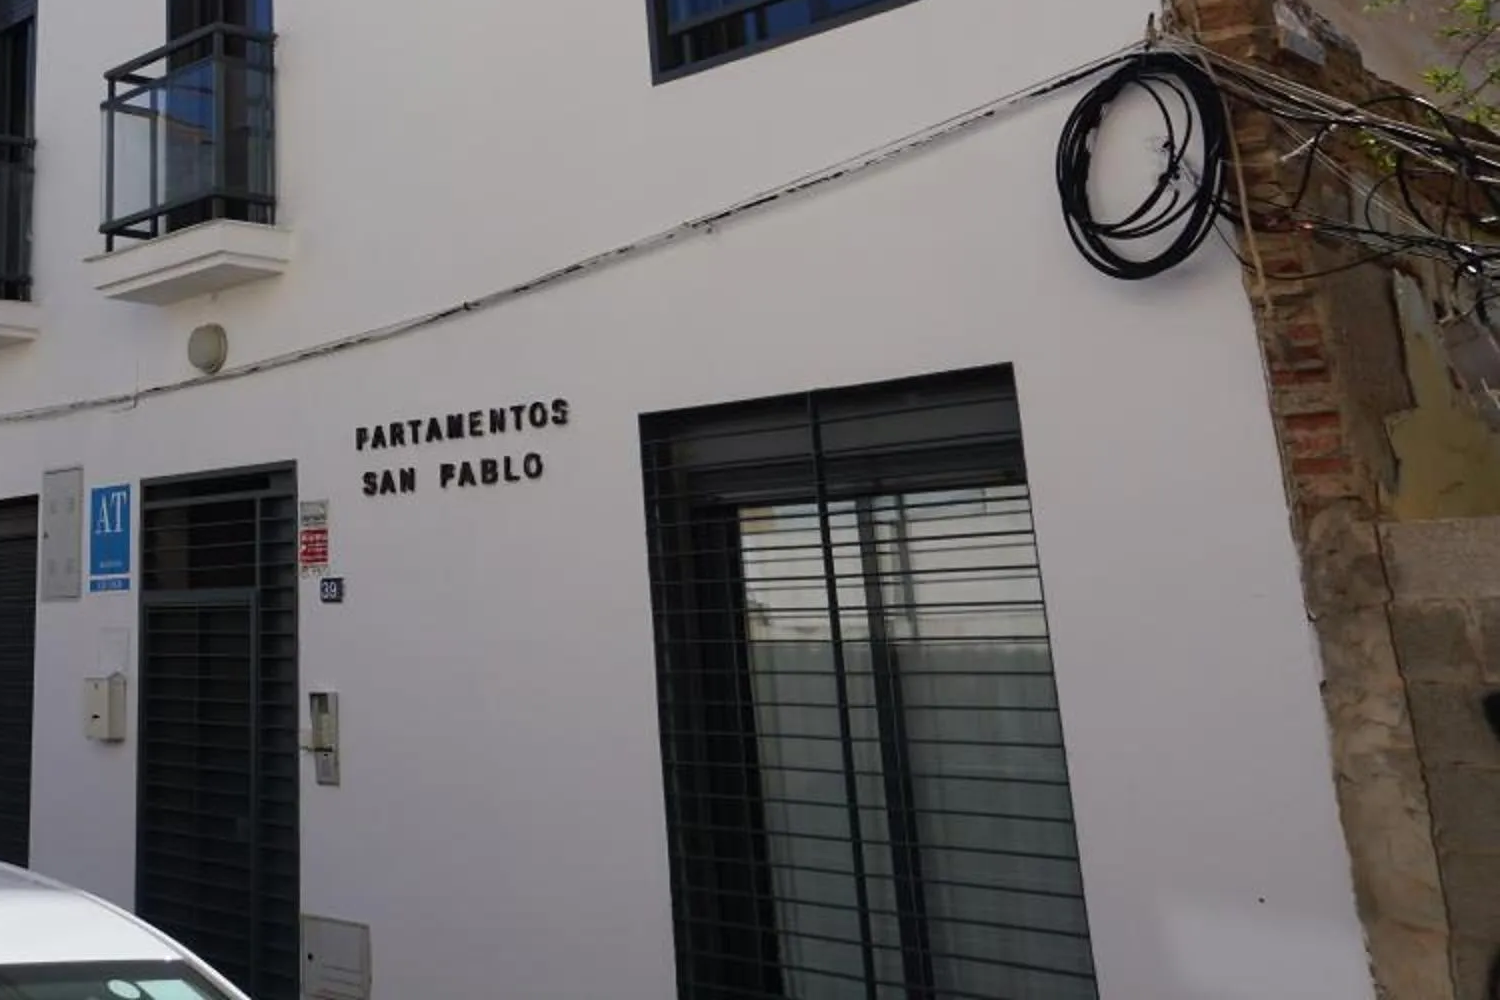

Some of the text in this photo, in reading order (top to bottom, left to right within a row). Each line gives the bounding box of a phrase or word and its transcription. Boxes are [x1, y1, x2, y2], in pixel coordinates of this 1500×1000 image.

[355, 398, 570, 451] PARTAMENTOS
[362, 452, 544, 497] SAN PABLO
[95, 491, 127, 534] AT
[321, 581, 338, 600] 39
